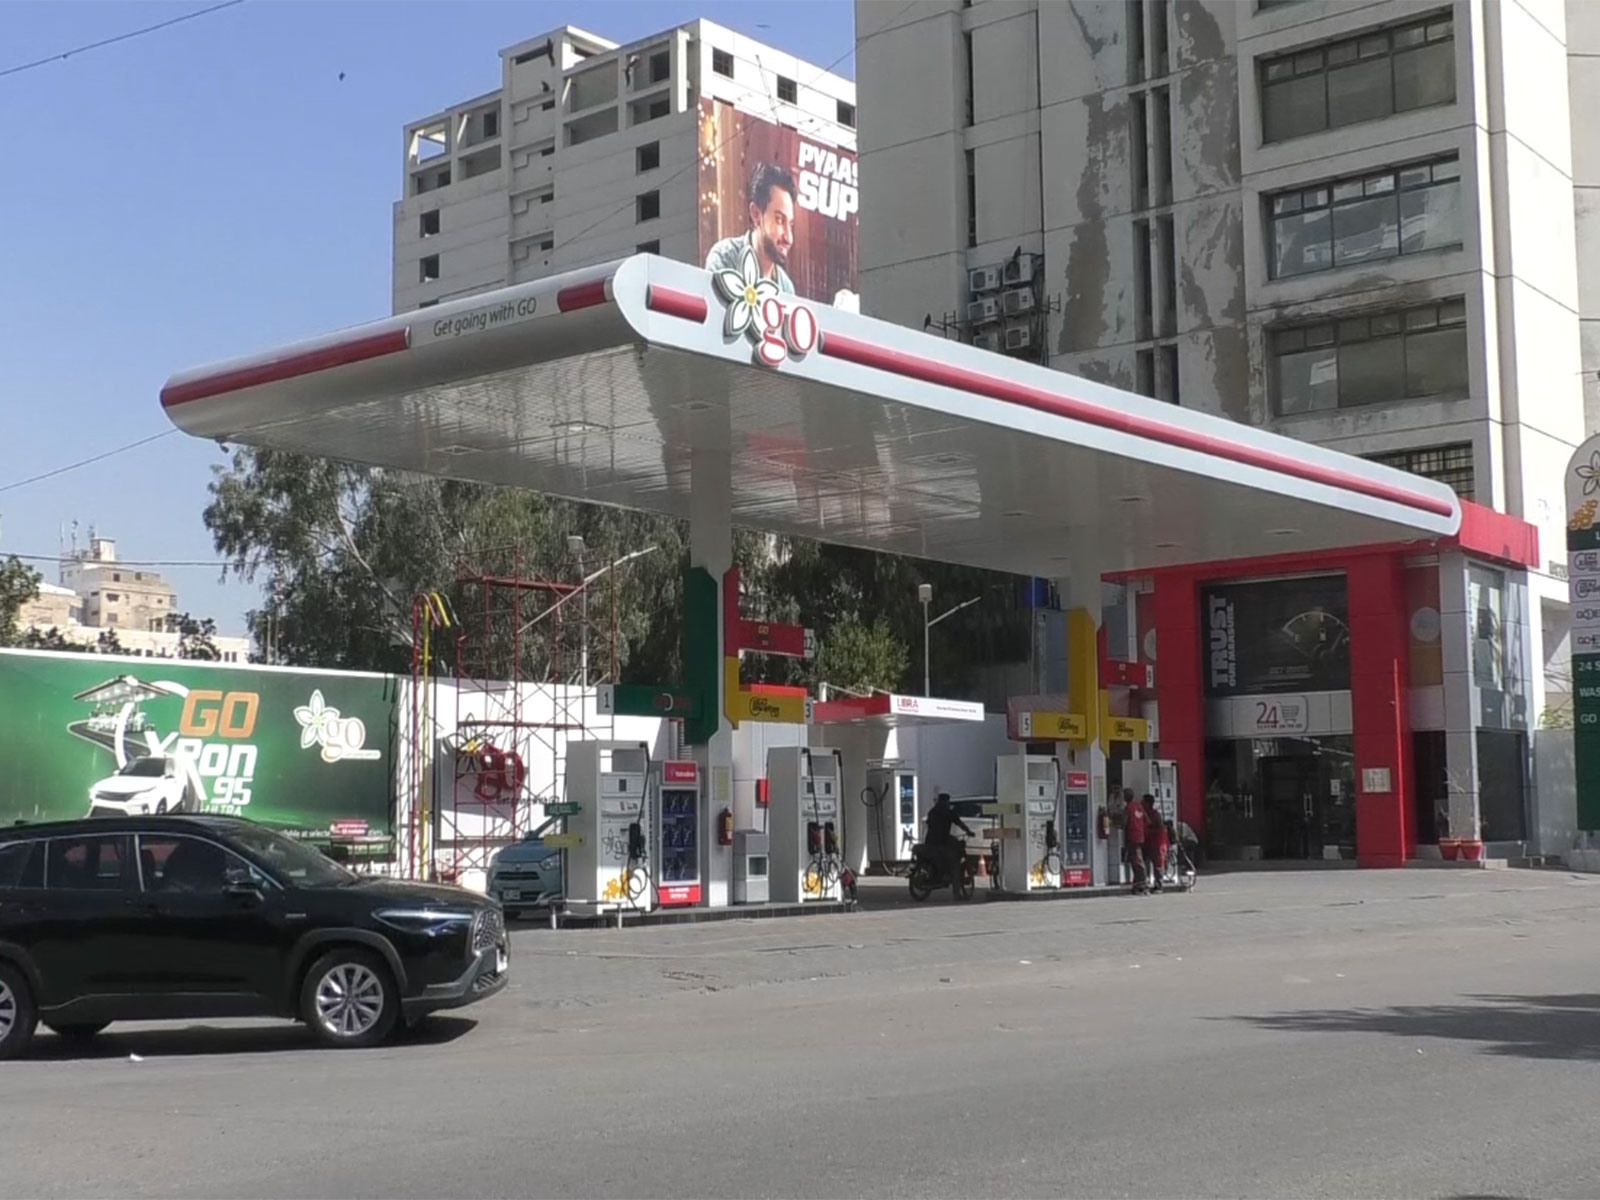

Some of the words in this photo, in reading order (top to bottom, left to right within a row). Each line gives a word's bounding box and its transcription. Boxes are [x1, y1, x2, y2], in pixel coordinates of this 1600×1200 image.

[797, 169, 859, 222] SUP
[433, 320, 453, 336] Get
[454, 311, 488, 336] going
[489, 301, 515, 323] with
[517, 296, 537, 317] GO
[759, 297, 818, 365] go
[1209, 594, 1228, 688] TRUST
[180, 690, 259, 738] GO
[604, 691, 611, 708] 1
[805, 702, 812, 718] 3
[1255, 701, 1280, 724] 24
[1580, 713, 1597, 724] GO
[210, 776, 254, 805] 95
